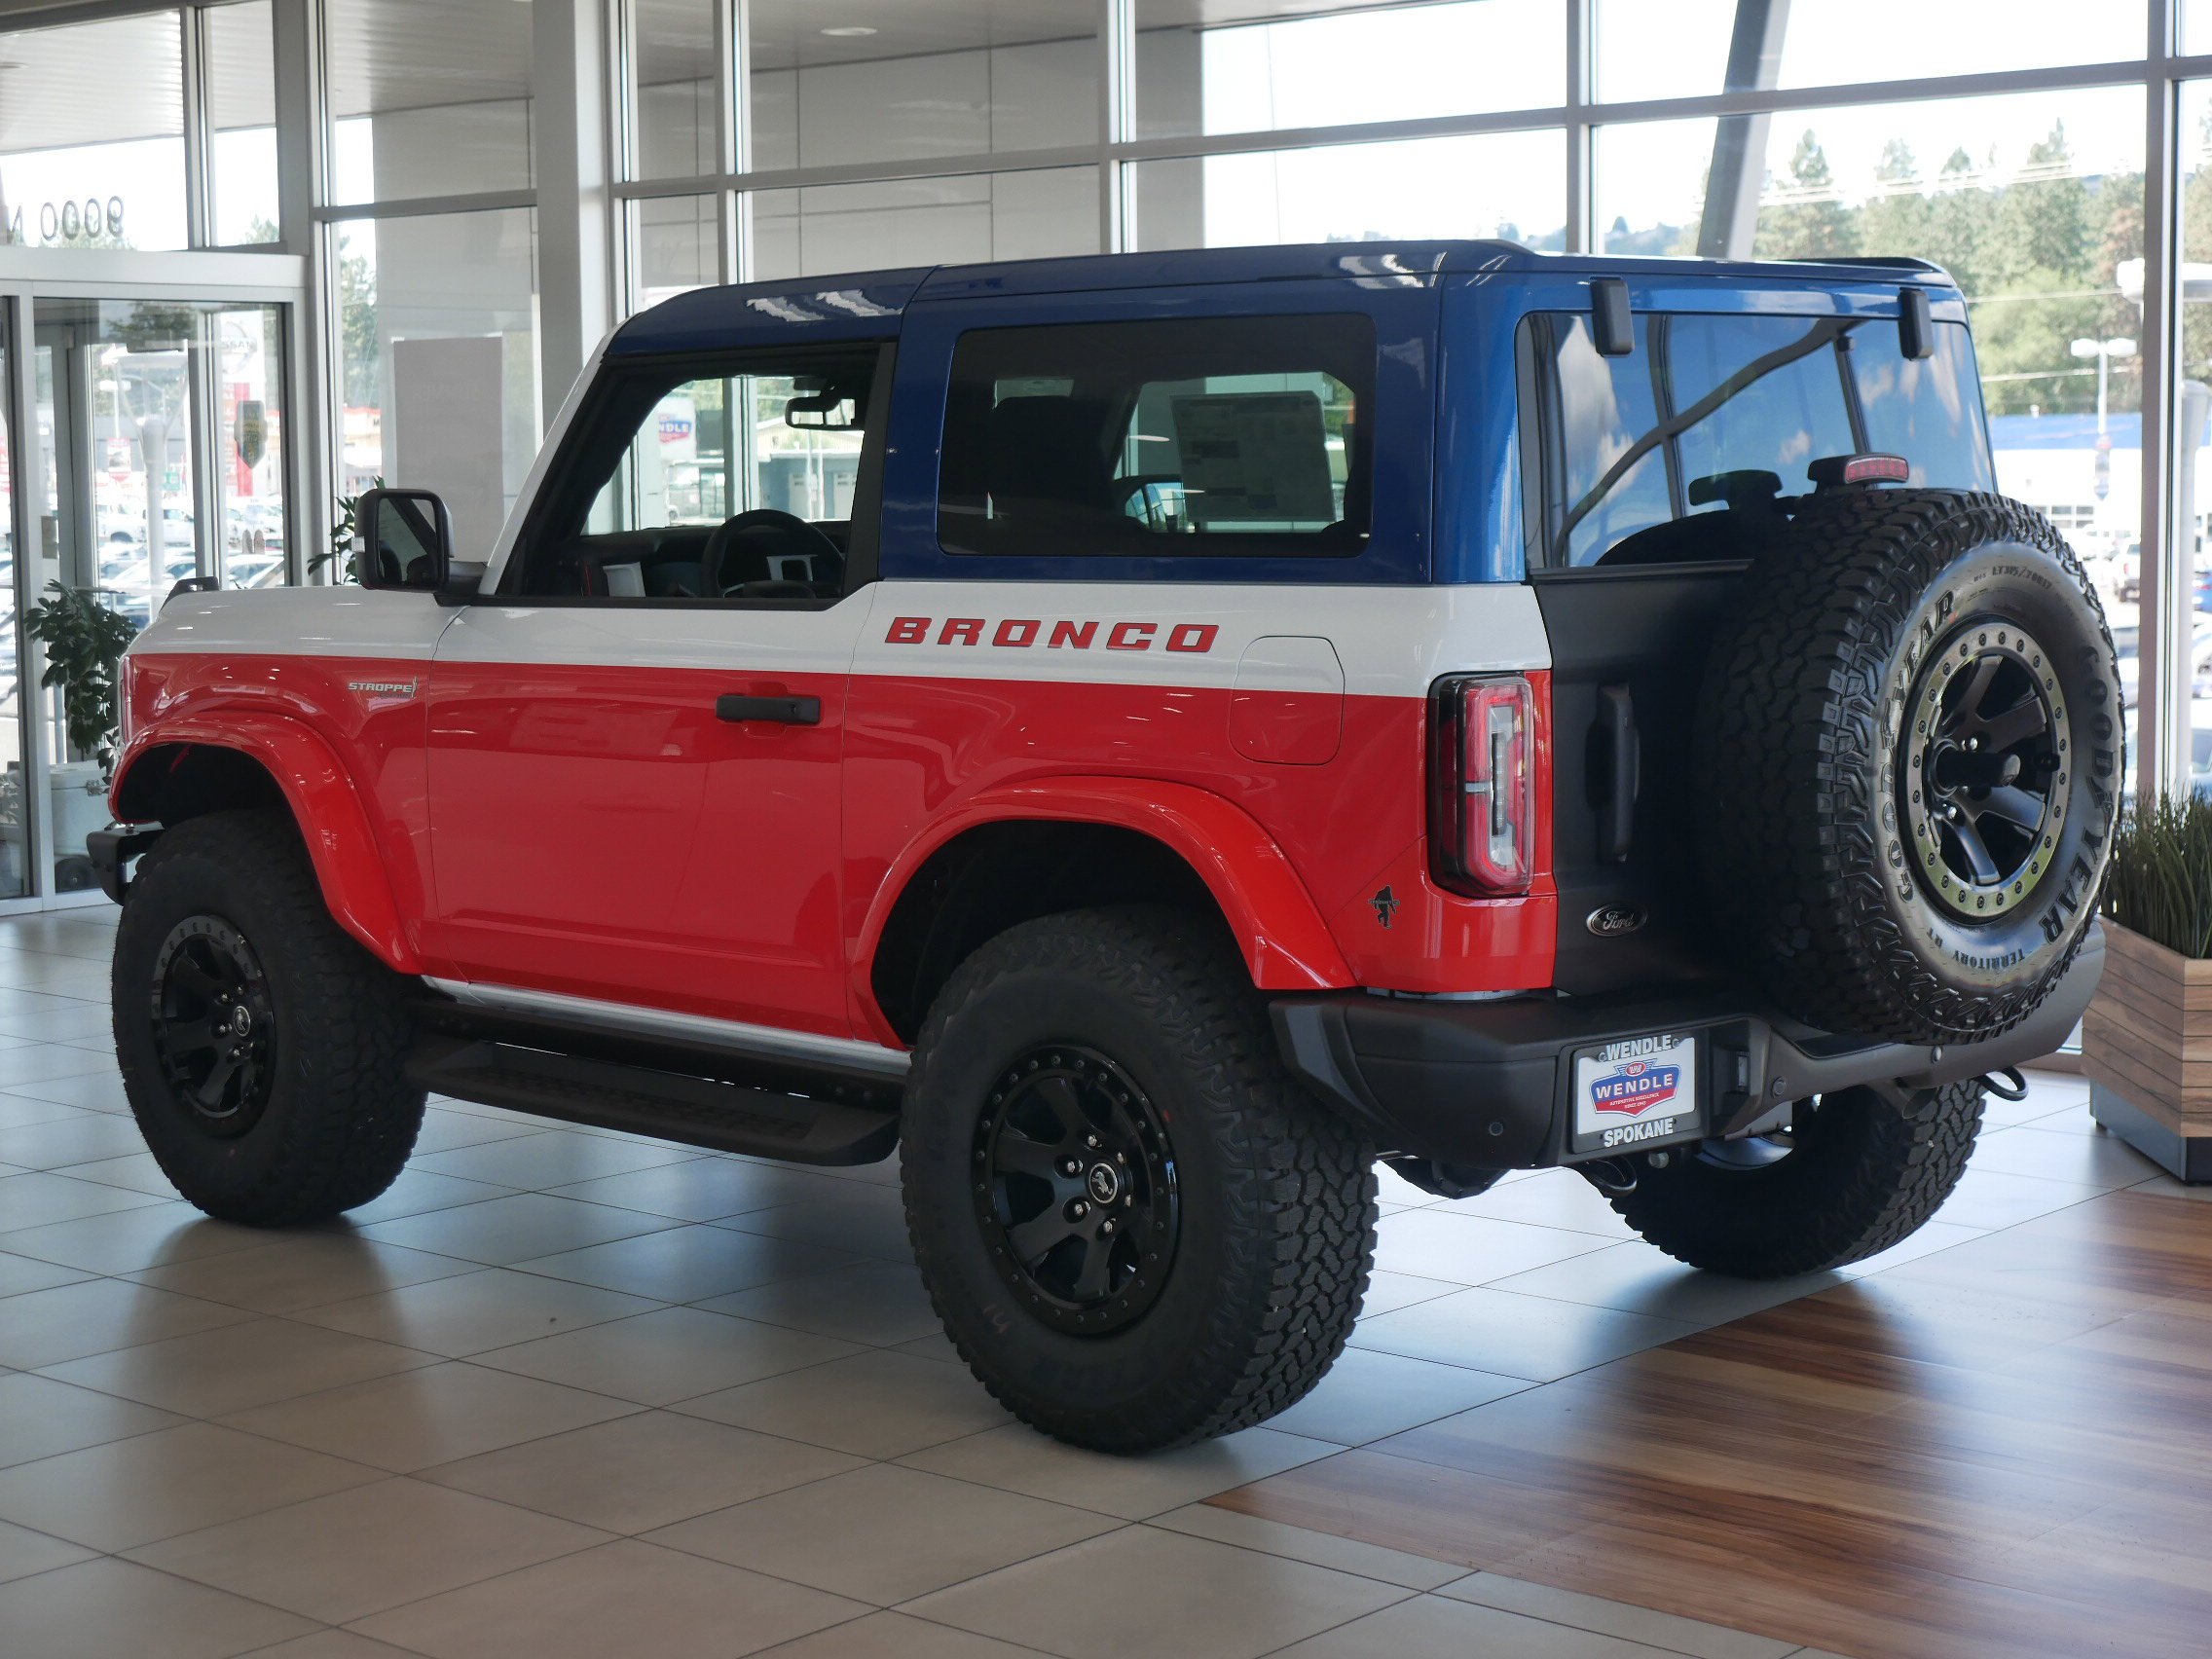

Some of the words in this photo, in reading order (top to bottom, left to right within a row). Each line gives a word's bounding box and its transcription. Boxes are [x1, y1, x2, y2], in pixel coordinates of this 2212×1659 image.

[884, 616, 1220, 653] BRONCO
[348, 682, 413, 693] STROPPE
[1603, 910, 1635, 931] Ford
[1952, 948, 2025, 970] TERRITORY
[1606, 1034, 1672, 1061] WENDLE
[1596, 1073, 1674, 1099] WENDLE
[1604, 1117, 1674, 1148] SPOKANE
